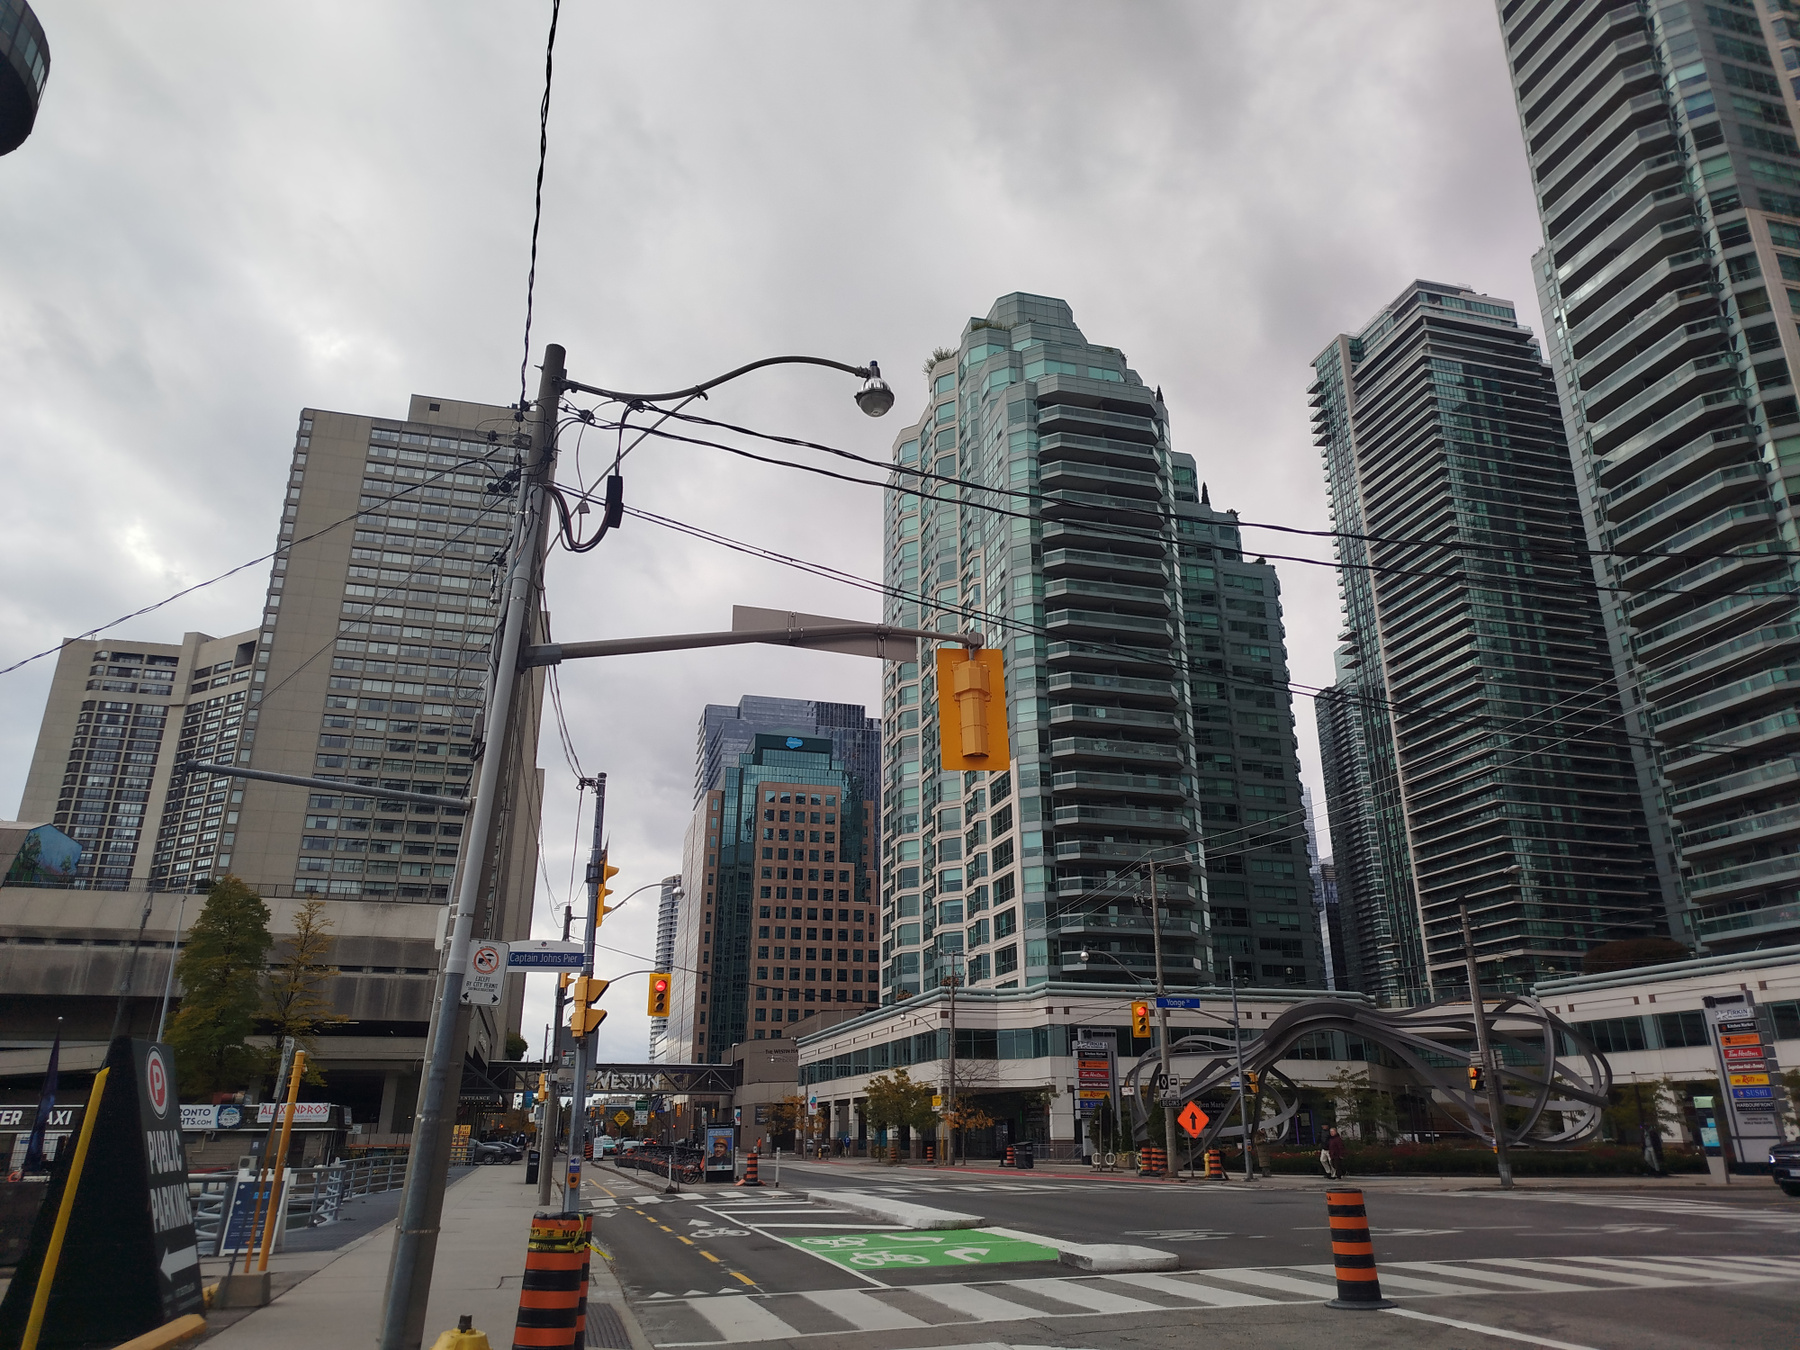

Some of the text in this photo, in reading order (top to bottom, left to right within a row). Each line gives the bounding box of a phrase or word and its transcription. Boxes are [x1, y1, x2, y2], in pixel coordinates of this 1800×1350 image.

[509, 952, 578, 964] Captain Johns Pier
[1166, 999, 1186, 1008] Yonge
[1738, 1048, 1758, 1057] Hortons
[152, 1064, 163, 1102] P
[593, 1070, 660, 1089] WESTIN
[1745, 1089, 1768, 1097] SUSHI
[260, 1104, 329, 1115] ALXNDROS
[46, 1110, 73, 1125] AXI
[147, 1129, 183, 1175] PUBLIC
[150, 1182, 193, 1234] PARKING
